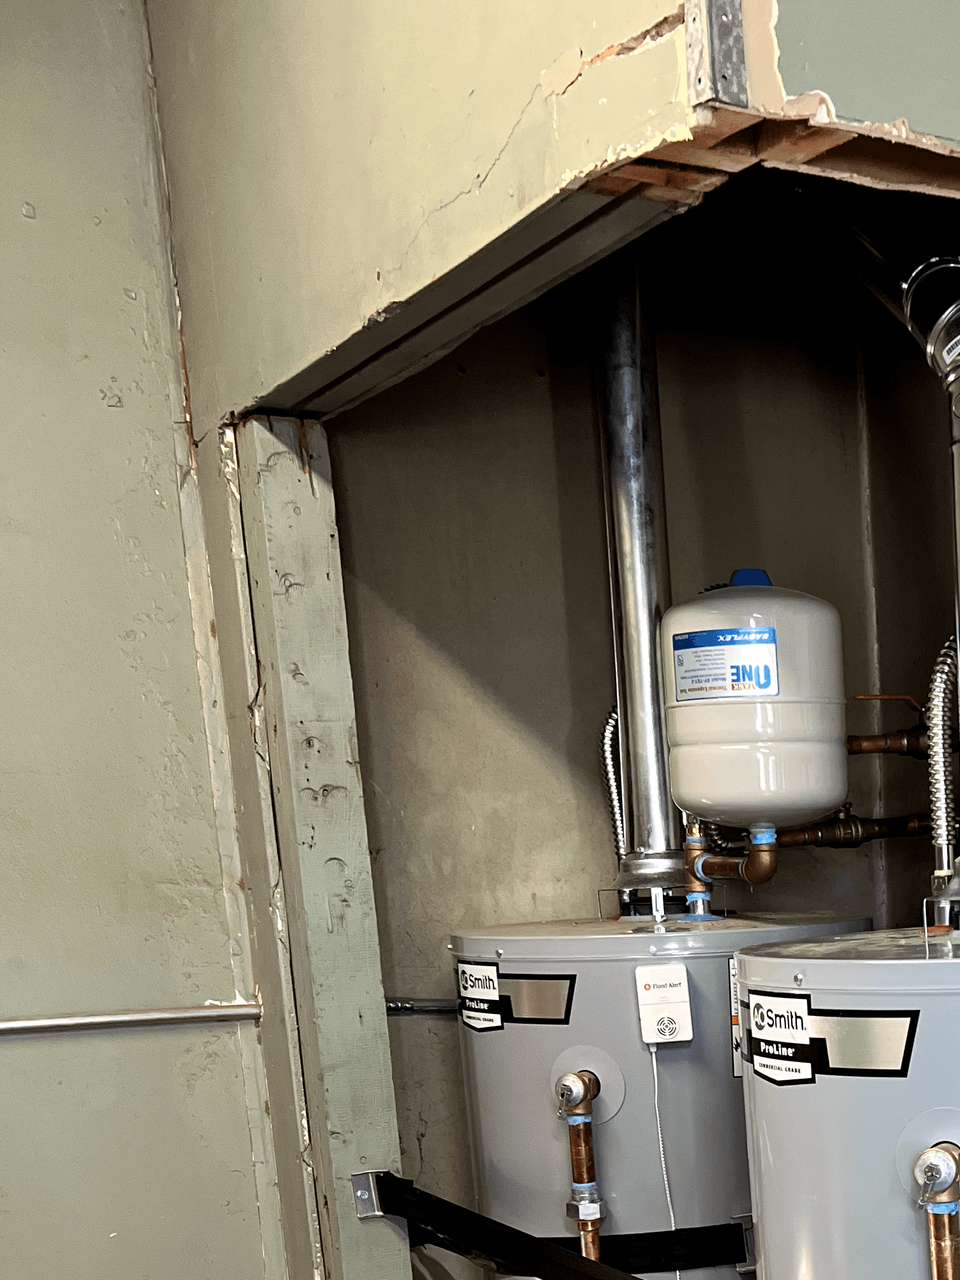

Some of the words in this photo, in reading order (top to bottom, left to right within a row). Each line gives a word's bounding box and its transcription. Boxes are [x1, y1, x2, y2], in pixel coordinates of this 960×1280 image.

[718, 633, 769, 642] EASYFLEX
[466, 999, 489, 1010] ProLine
[760, 1042, 795, 1056] ProLine
